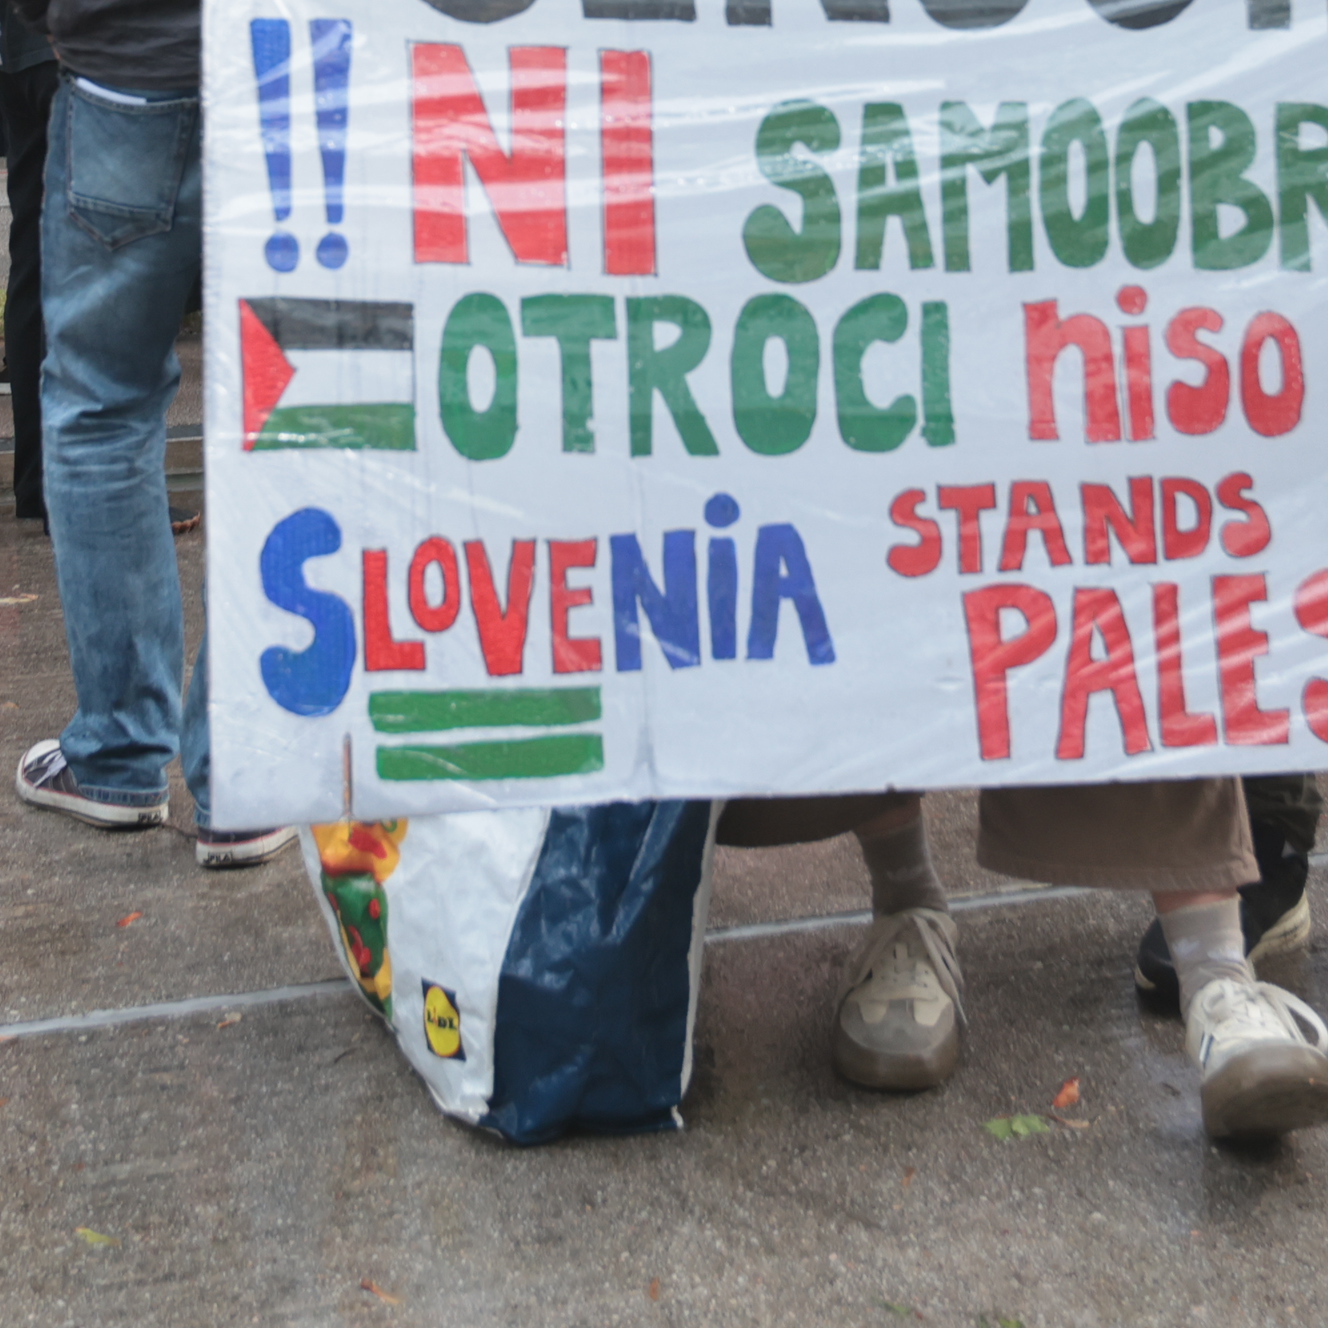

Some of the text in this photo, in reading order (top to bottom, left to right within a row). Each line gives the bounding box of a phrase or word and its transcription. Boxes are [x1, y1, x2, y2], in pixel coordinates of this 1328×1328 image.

[406, 39, 659, 277] NI
[436, 291, 956, 462] OTROCI
[886, 471, 1272, 577] STANDS
